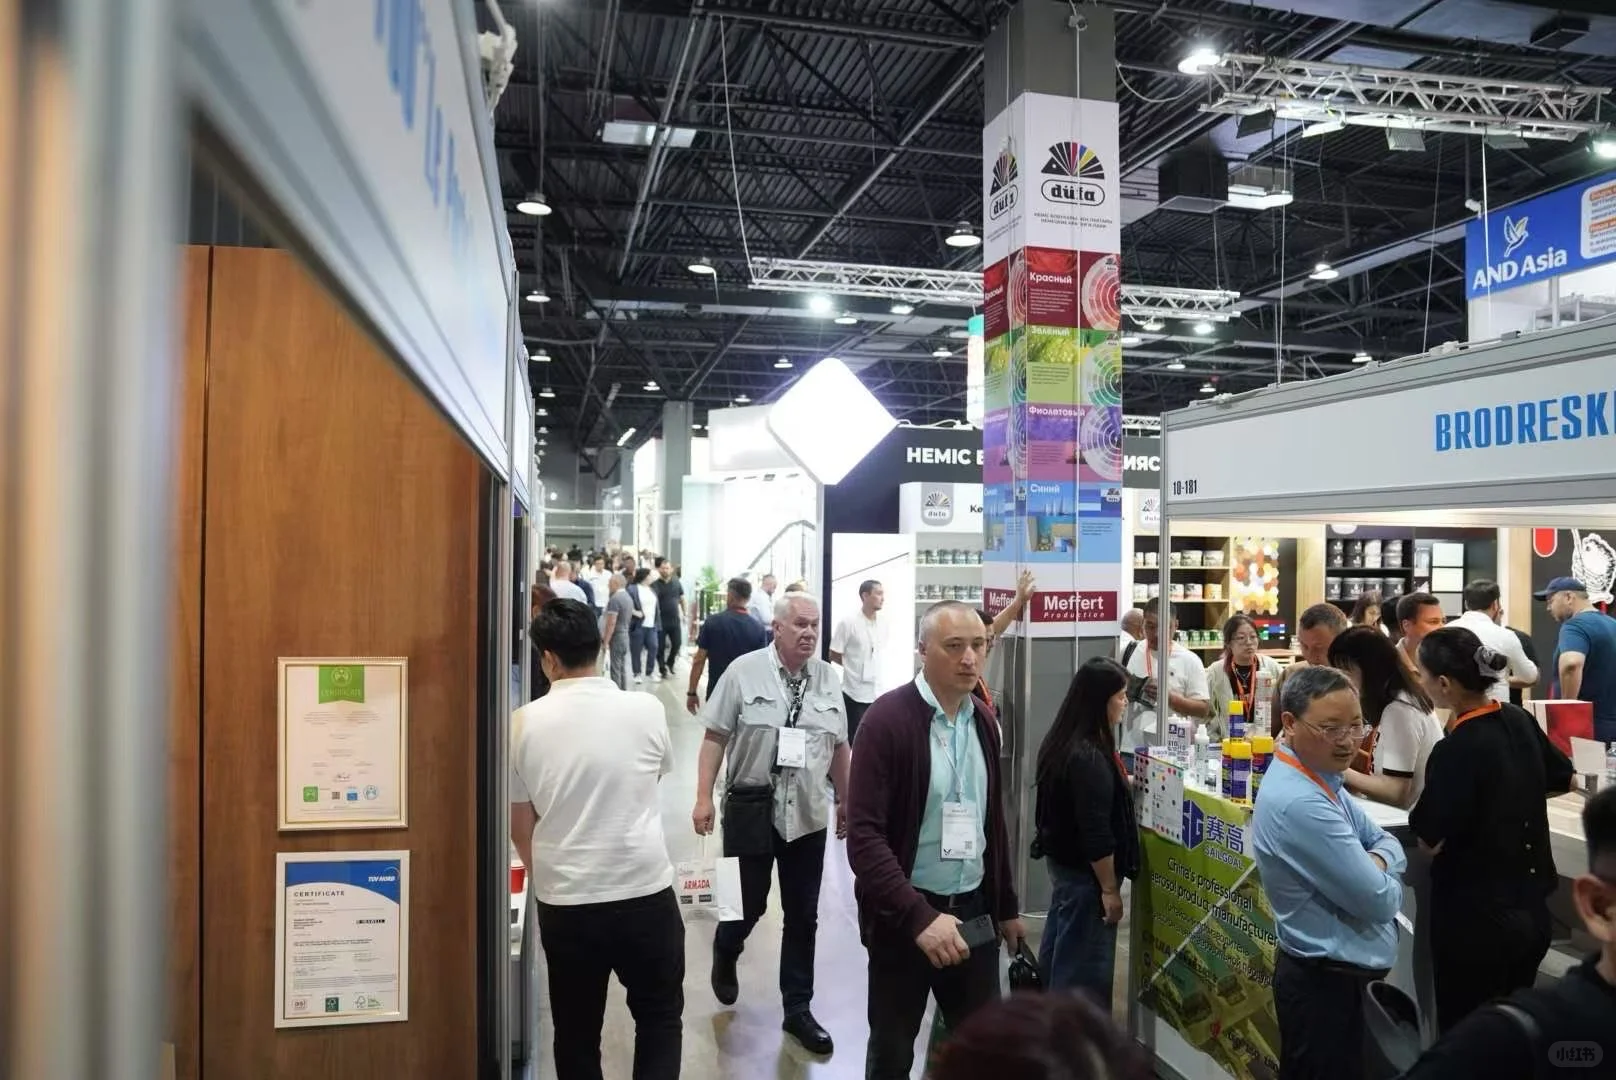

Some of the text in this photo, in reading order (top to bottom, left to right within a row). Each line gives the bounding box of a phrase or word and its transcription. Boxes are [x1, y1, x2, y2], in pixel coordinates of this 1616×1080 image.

[1029, 272, 1072, 284] Красный
[1473, 247, 1568, 290] AND Asia
[1030, 483, 1060, 494] Синий
[1172, 480, 1198, 496] 10-181
[1044, 595, 1104, 611] Meffert
[1206, 815, 1244, 854] 赛高
[1204, 847, 1245, 870] SAILGOAL
[683, 879, 711, 890] ARMADA
[1167, 857, 1253, 912] China's professional
[1212, 904, 1278, 947] manufacturer
